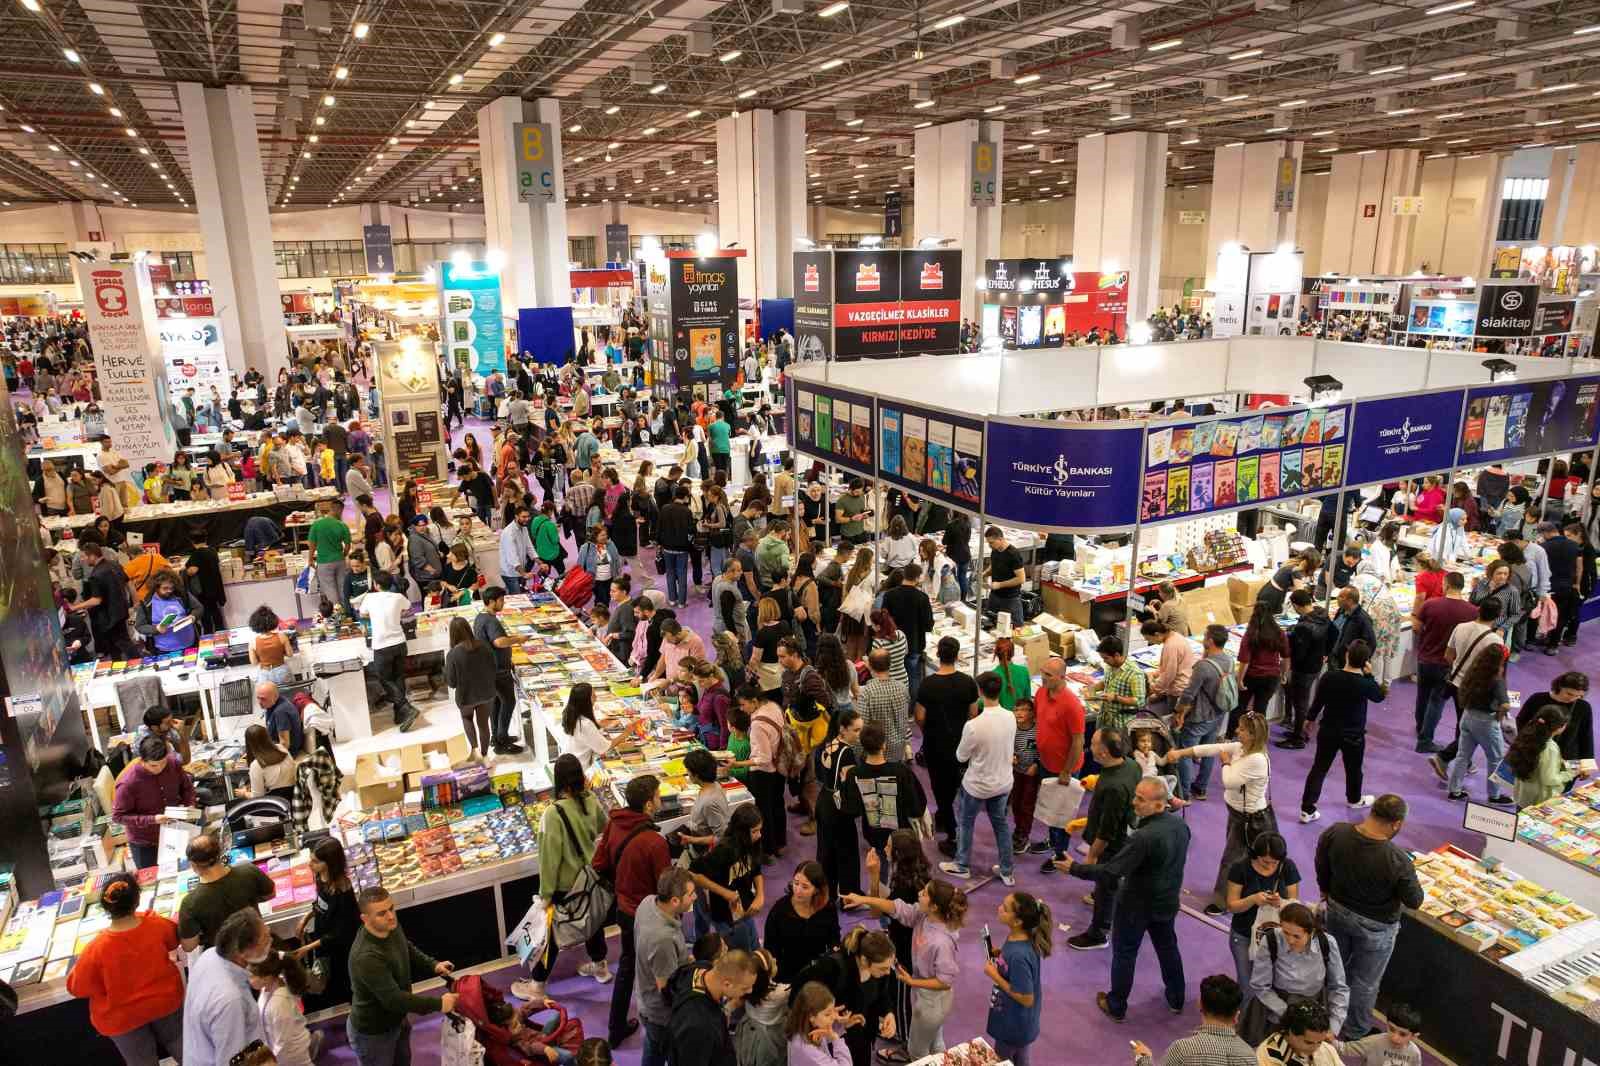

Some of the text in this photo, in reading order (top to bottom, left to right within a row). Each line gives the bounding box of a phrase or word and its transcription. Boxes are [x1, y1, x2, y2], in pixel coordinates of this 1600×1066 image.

[523, 128, 545, 161] B
[521, 171, 552, 187] a c
[848, 307, 950, 323] VAZGEÇİLMEZ KLASİKLER
[1481, 314, 1532, 330] siakitap
[862, 326, 938, 344] KIRMIZI KEDİ'DE
[104, 368, 146, 379] TULLET
[1012, 461, 1053, 475] TÜRKİYE
[1069, 466, 1113, 476] BANKASI
[1024, 485, 1096, 499] Kültür Yayınları
